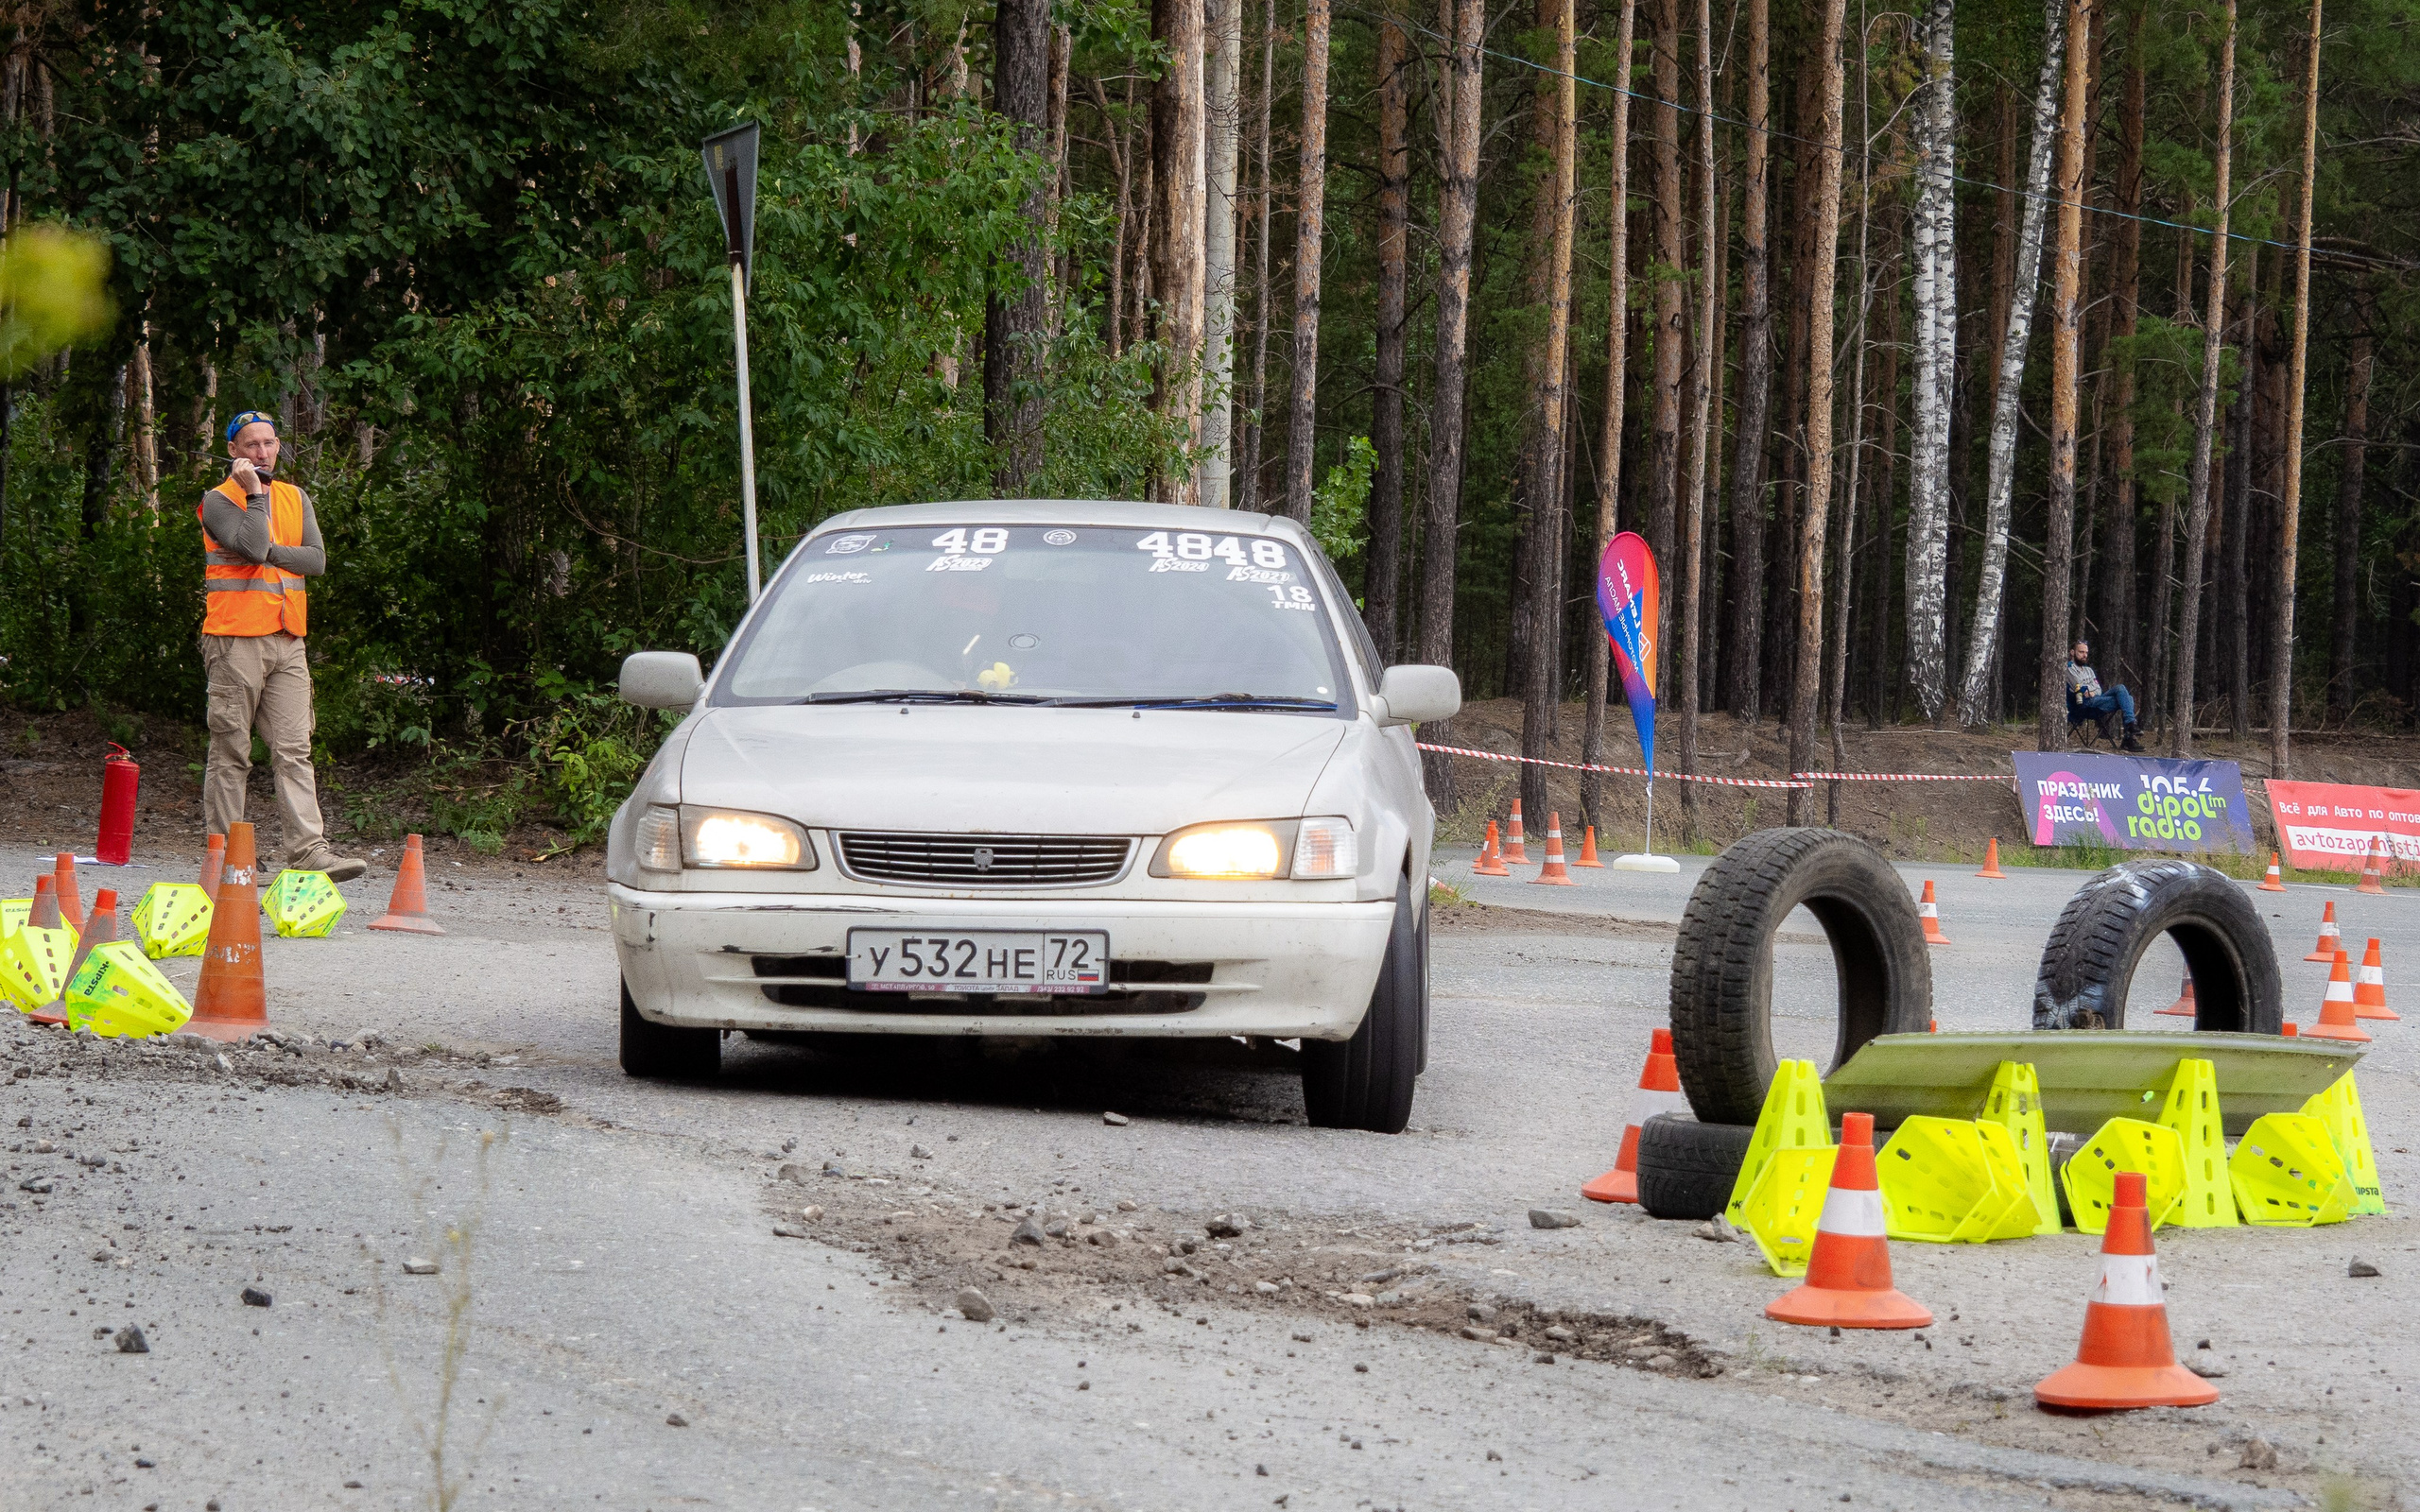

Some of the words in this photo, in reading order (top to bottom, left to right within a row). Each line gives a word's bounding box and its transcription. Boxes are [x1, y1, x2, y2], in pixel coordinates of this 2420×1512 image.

[931, 528, 1010, 554] 48
[1136, 531, 1213, 560] 48
[1213, 537, 1287, 569] 48
[807, 572, 869, 583] Winter
[1267, 584, 1313, 603] 18
[1271, 601, 1316, 611] TMN
[2036, 780, 2124, 799] ПРАЗДНИК
[2208, 794, 2226, 808] fm
[2279, 801, 2301, 815] Всё
[2308, 805, 2328, 816] для
[2334, 806, 2363, 818] Авто
[2368, 810, 2384, 819] по
[2043, 804, 2100, 823] ЗДЕСЬ!
[2127, 815, 2202, 841] radio
[1050, 937, 1090, 969] 72
[1046, 970, 1077, 981] RUS
